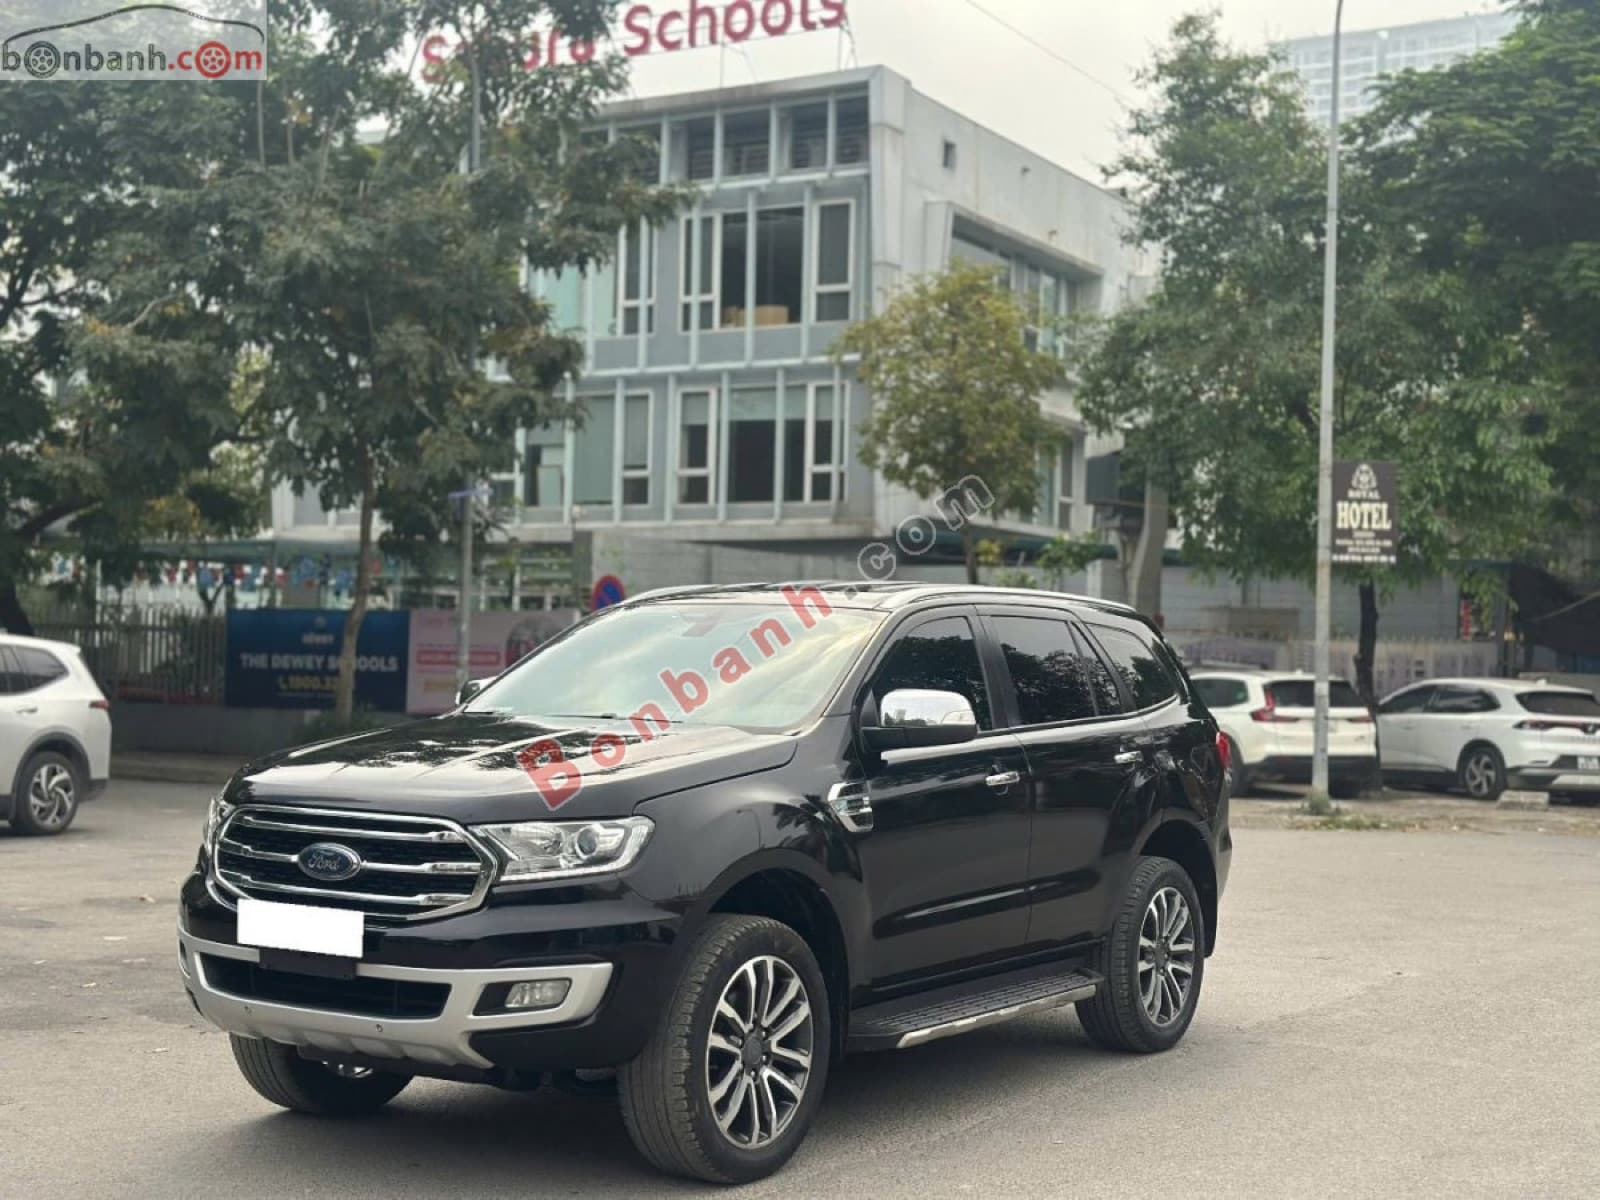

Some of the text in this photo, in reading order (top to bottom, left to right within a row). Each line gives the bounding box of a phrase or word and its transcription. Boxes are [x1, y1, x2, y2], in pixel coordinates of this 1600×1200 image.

[623, 0, 846, 57] Schools
[1336, 501, 1393, 530] HOTEL
[240, 653, 268, 669] THE
[271, 654, 325, 670] DEWEY
[308, 850, 341, 871] Ford
